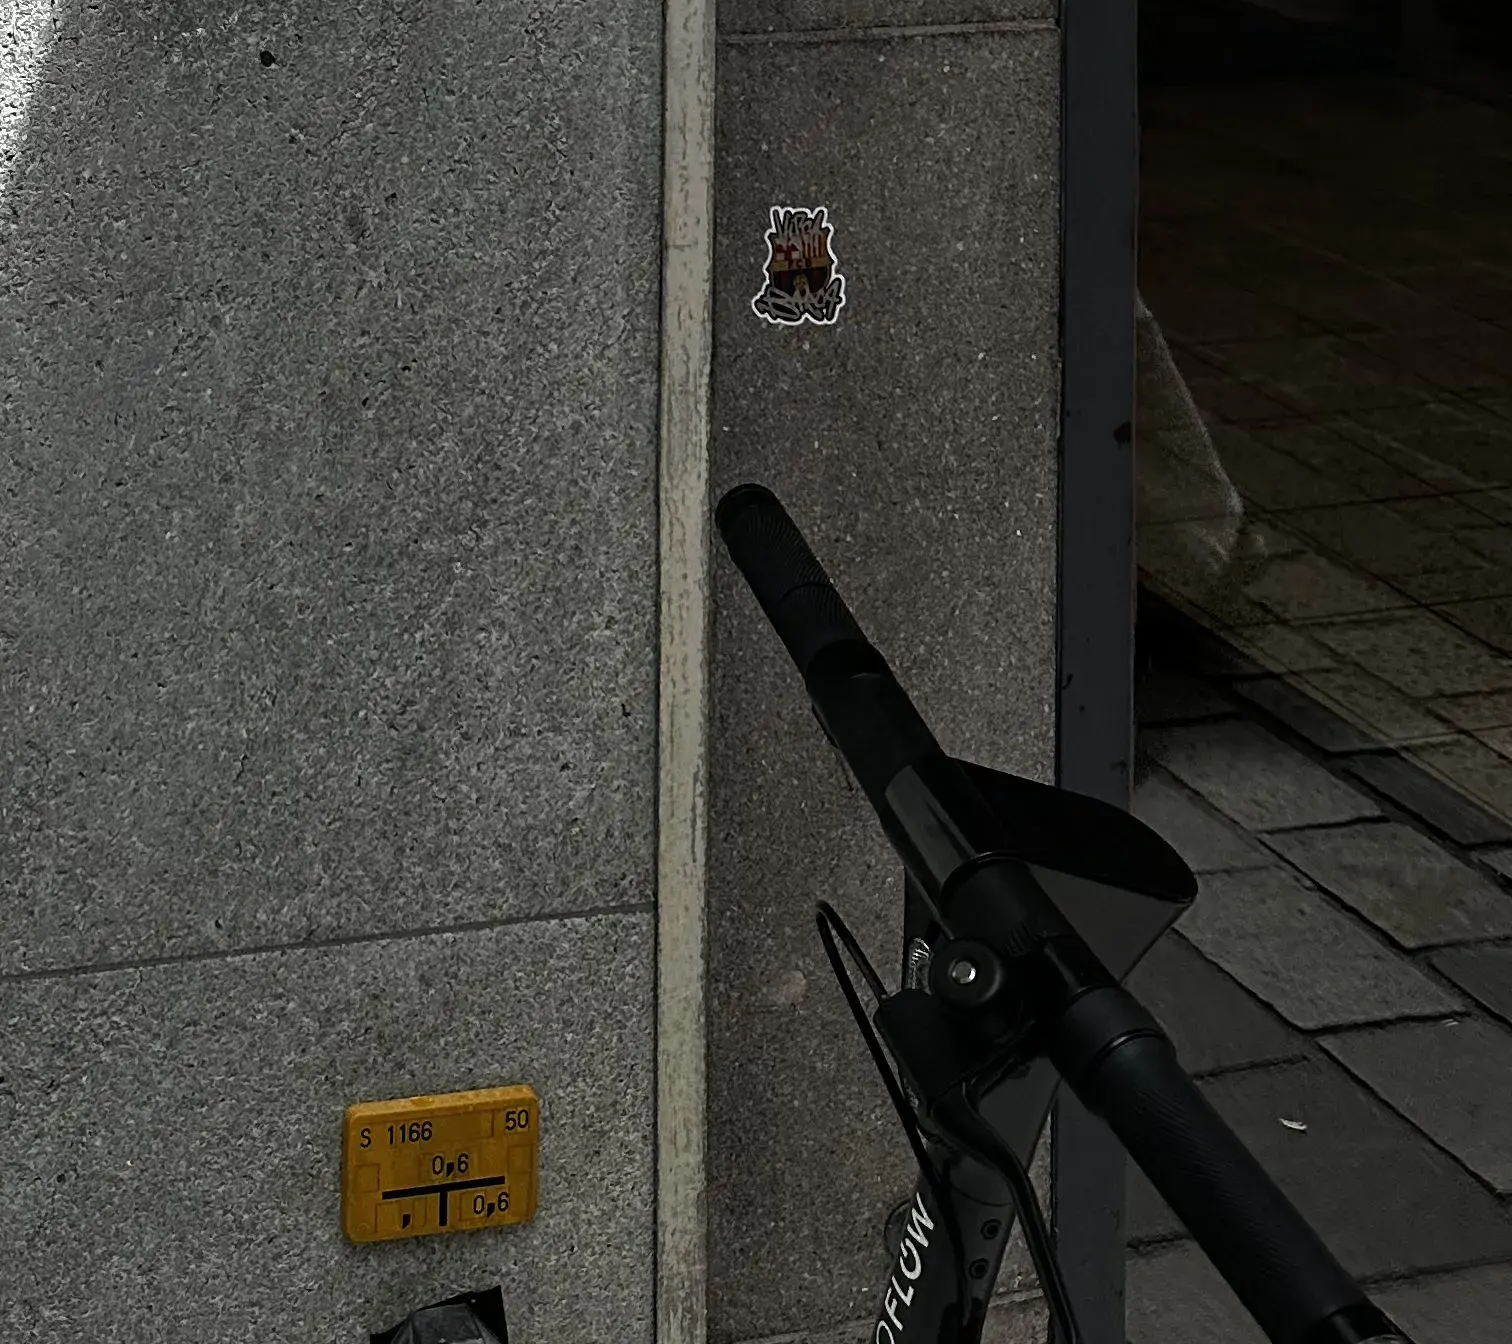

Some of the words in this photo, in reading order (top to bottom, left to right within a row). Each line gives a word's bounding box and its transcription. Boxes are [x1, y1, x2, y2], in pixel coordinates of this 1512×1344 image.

[359, 1128, 372, 1148] S
[387, 1121, 433, 1145] 1166
[504, 1109, 529, 1131] 50
[431, 1153, 470, 1177] 0,6
[472, 1191, 510, 1217] 0,6
